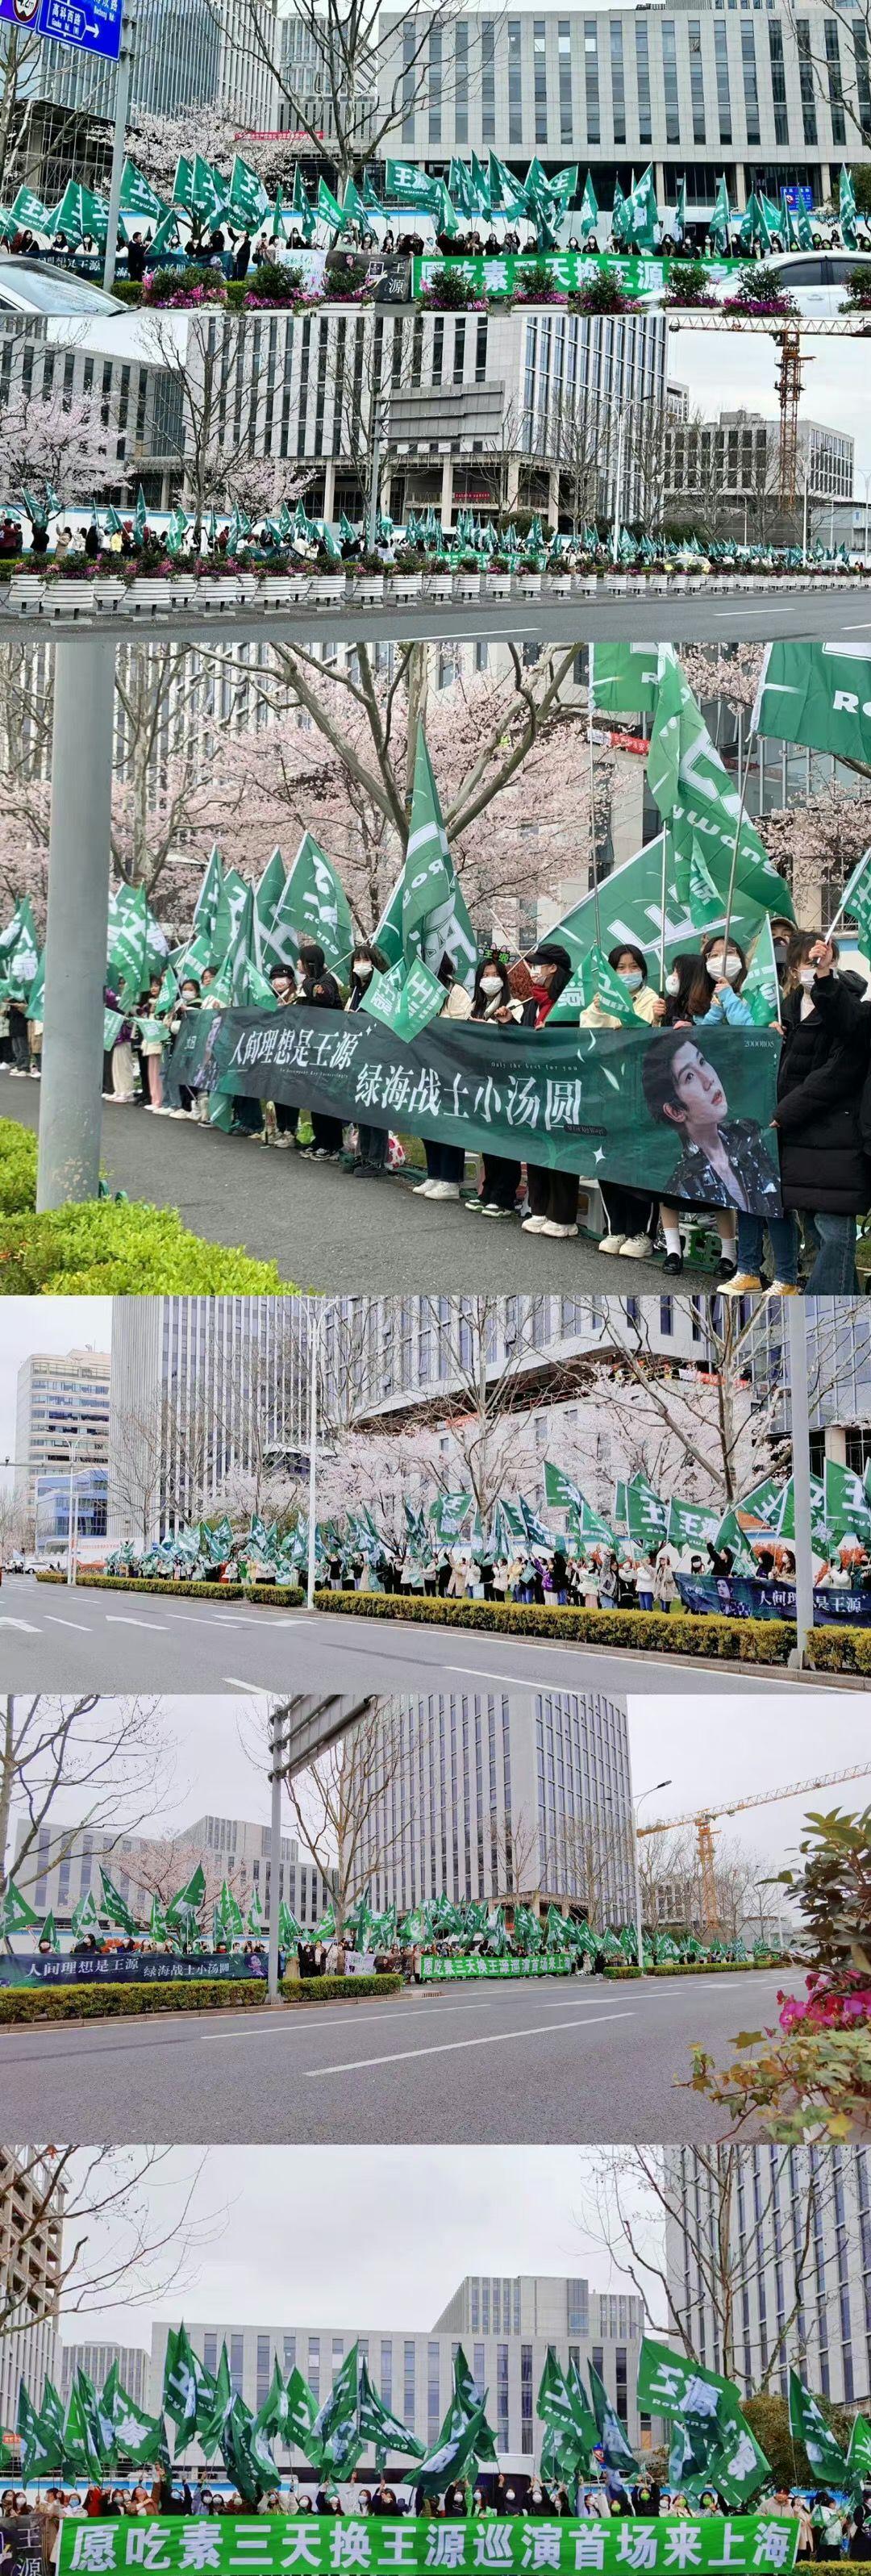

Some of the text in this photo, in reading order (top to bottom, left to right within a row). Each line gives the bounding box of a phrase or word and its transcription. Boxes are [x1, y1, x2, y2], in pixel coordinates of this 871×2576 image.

[52, 3, 81, 27] 高科西路
[389, 262, 405, 294] 王源
[228, 1028, 362, 1070] 人间理想是王源
[355, 1063, 582, 1131] 绿海战士小汤圆
[760, 1589, 861, 1613] 人间理是王源
[25, 1958, 230, 1977] 人间理想是王源 绿海战士小汤圆
[423, 1957, 571, 1976] 愿吃素三天换王源巡演首场来上海
[16, 2526, 42, 2576] 王源
[69, 2520, 792, 2572] 愿吃素三天换王源巡演首场来上海
